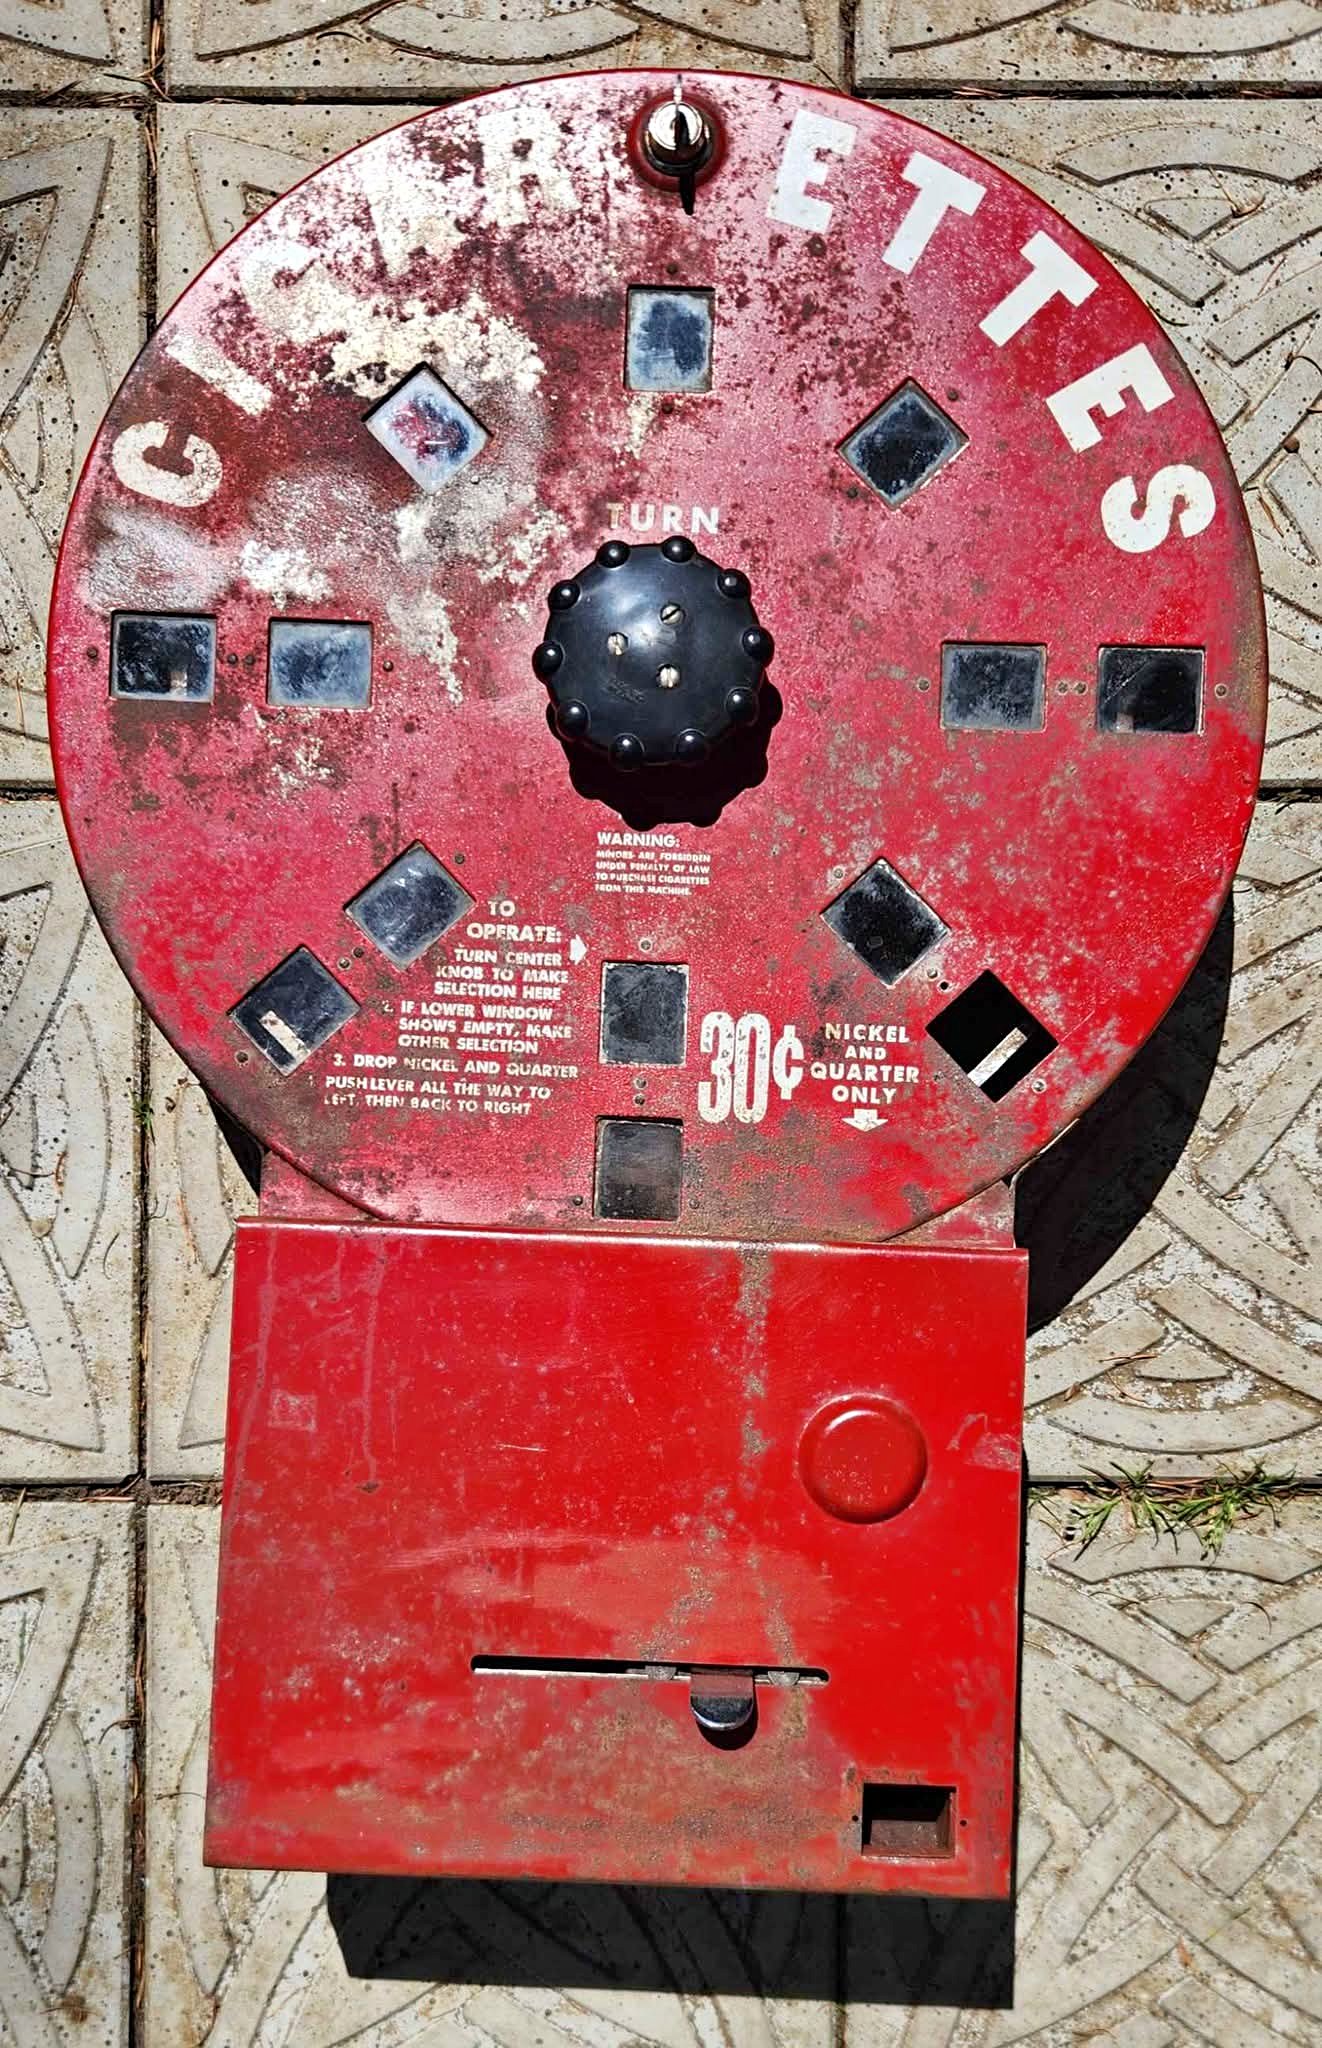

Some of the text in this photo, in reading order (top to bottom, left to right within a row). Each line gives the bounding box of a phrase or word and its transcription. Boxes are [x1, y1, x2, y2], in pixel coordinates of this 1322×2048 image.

[606, 503, 720, 534] TURN
[597, 832, 681, 847] WARNING:
[638, 852, 655, 860] ARE
[660, 852, 711, 862] FORBIDDEN
[596, 861, 711, 874] UNDER PENALTY OF LAW
[595, 872, 710, 885] TO PURCHASE CIGARETTES
[595, 884, 621, 892] FROM
[623, 885, 644, 894] THIS
[487, 900, 516, 917] TO
[466, 922, 562, 943] OPERATE:
[454, 948, 562, 966] TURN CENTER
[436, 965, 569, 983] KNOB TO MAKE
[434, 981, 561, 1000] SELECTION HERE
[401, 1000, 415, 1014] IF
[421, 1002, 475, 1018] LOWER
[481, 1003, 553, 1020] WINDOW
[399, 1017, 572, 1039] SHOWS EMPTY, MAKE
[825, 1023, 910, 1043] NICKEL
[398, 1034, 538, 1054] OTHER SELECTION
[845, 1045, 887, 1060] AND
[333, 1053, 578, 1078] 3. DROP NICKEL AND QUARTER
[697, 1011, 804, 1124] 30¢
[810, 1062, 920, 1083] QUARTER
[325, 1075, 367, 1089] PUSH
[369, 1078, 415, 1092] LEVER
[420, 1081, 448, 1094] ALL
[453, 1081, 482, 1096] THE
[486, 1084, 524, 1098] WAY
[529, 1086, 552, 1100] TO
[832, 1085, 898, 1104] ONLY
[365, 1094, 405, 1108] THEN
[410, 1097, 451, 1112] BACK
[457, 1100, 478, 1112] TO
[483, 1101, 532, 1115] RIGHT
